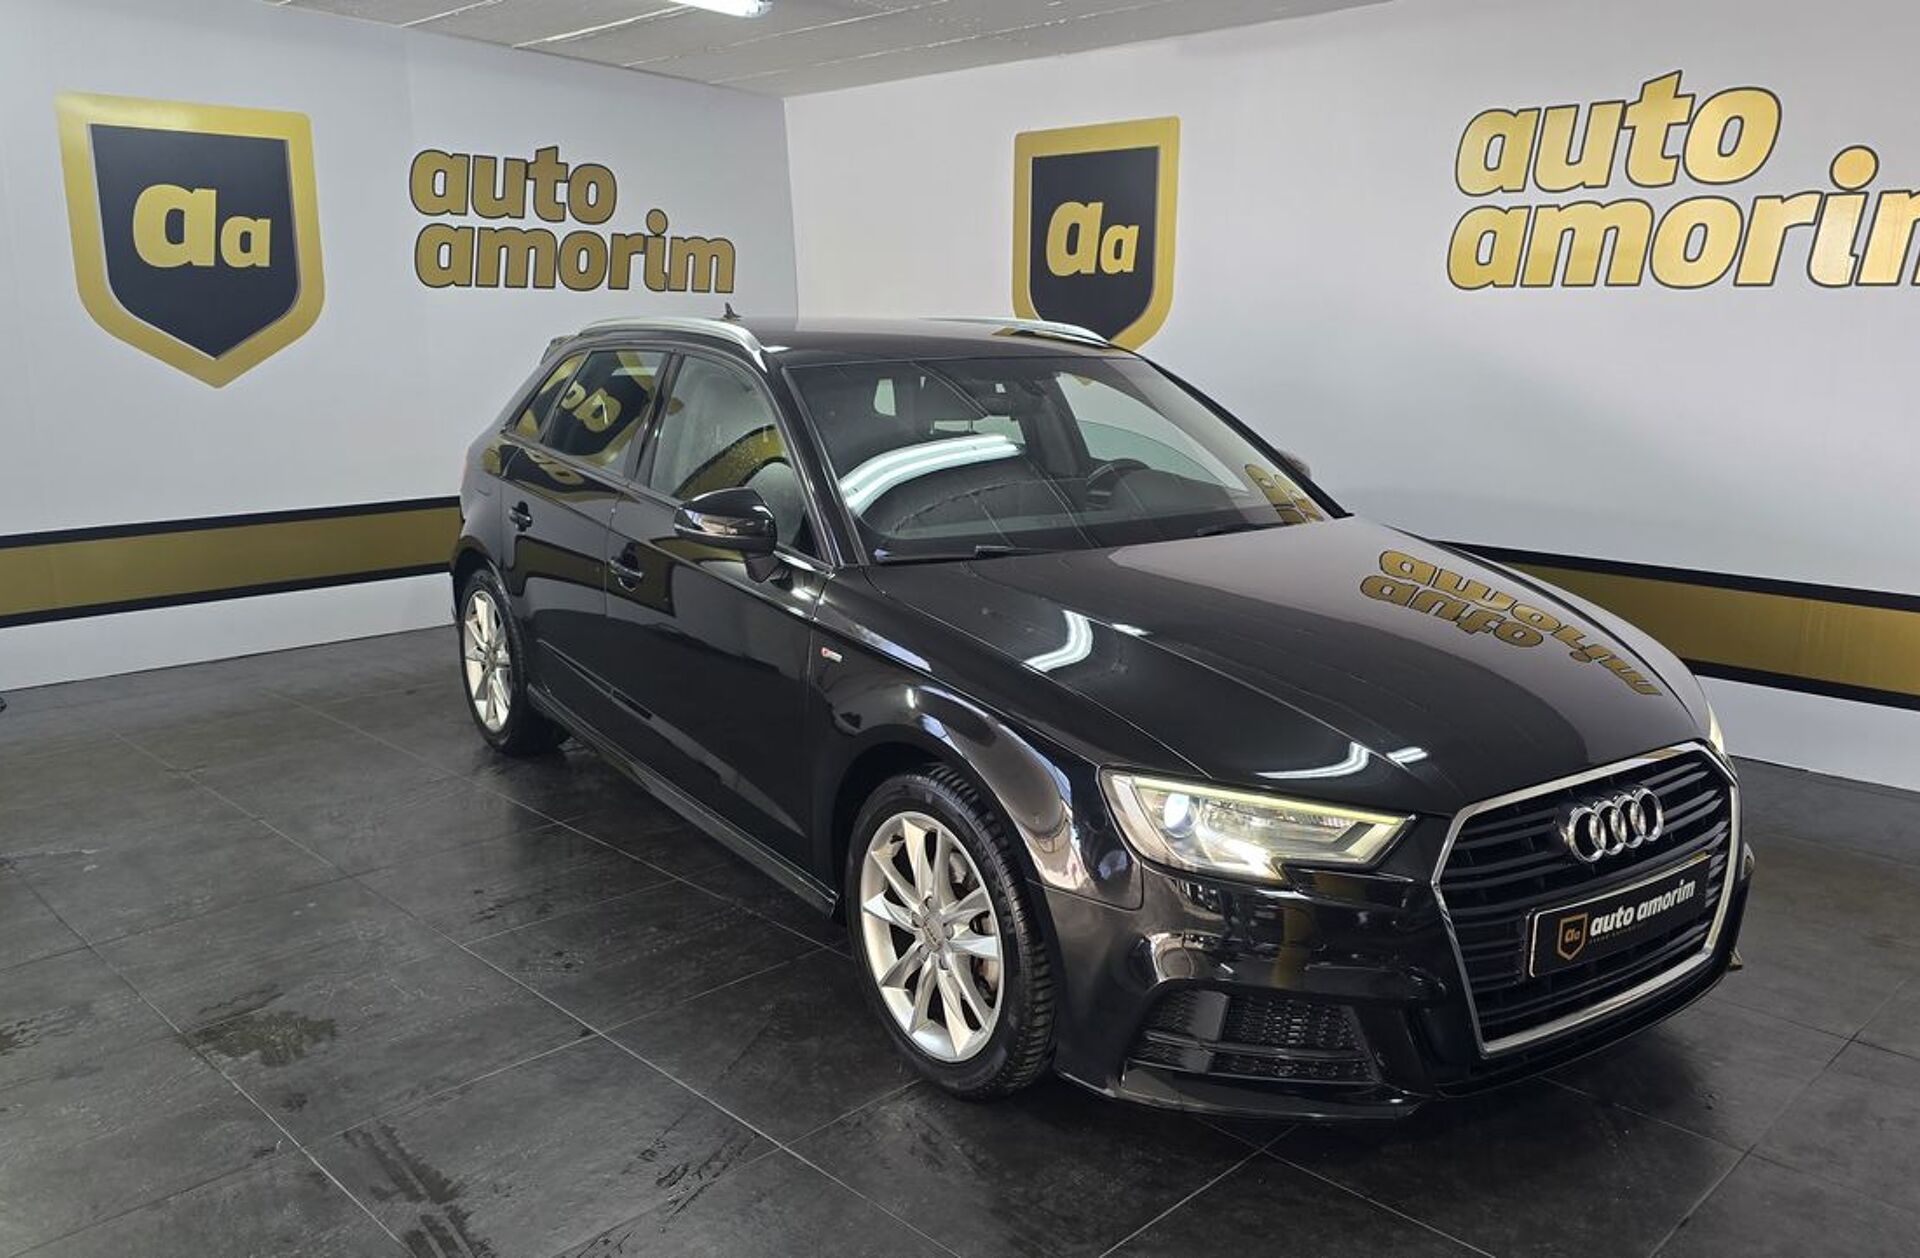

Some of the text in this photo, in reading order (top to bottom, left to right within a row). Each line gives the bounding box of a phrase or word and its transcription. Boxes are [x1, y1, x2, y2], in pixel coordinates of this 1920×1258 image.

[1455, 69, 1781, 197] auto
[409, 146, 617, 223] auto
[132, 184, 272, 268] aa
[415, 208, 735, 293] amorim
[1046, 201, 1139, 276] aa
[1590, 905, 1635, 936] auto
[1637, 878, 1696, 921] amorim
